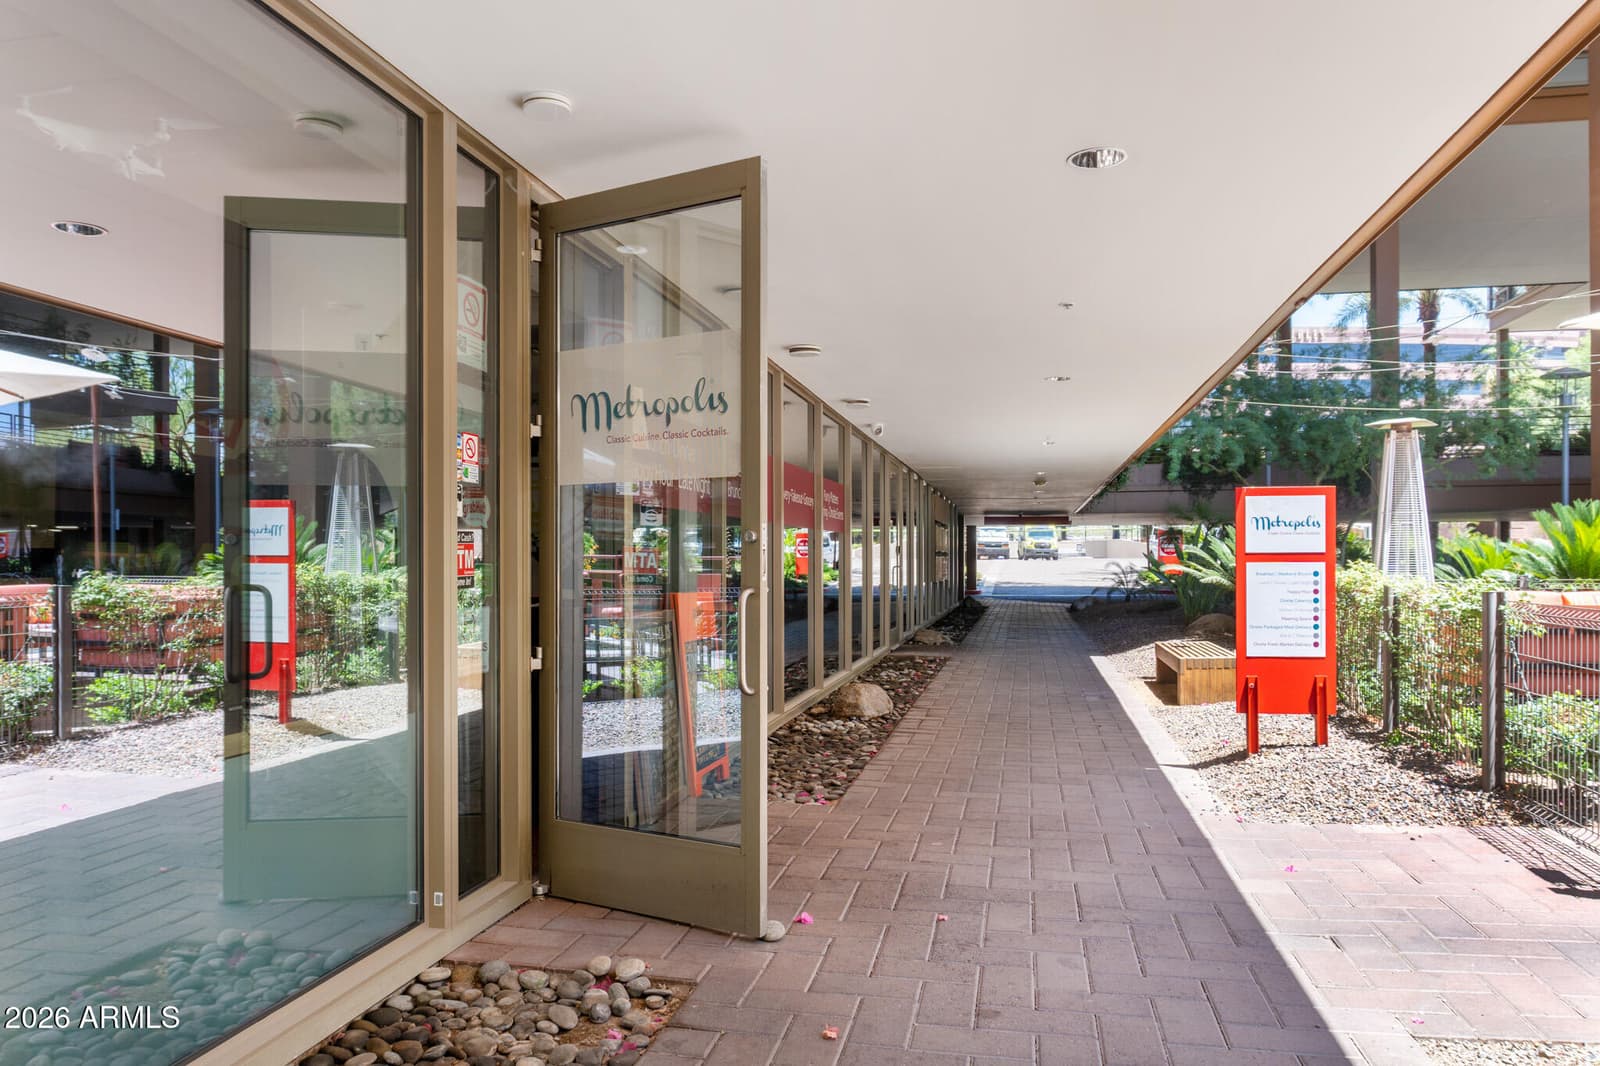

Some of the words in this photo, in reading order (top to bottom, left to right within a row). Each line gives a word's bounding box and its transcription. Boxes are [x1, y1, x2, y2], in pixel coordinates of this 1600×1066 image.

[571, 376, 728, 432] Metropolis
[606, 433, 631, 445] Classic
[662, 429, 689, 440] Classic
[690, 426, 729, 438] Cocktails.
[1251, 514, 1321, 531] Metropolis
[457, 549, 474, 569] TM
